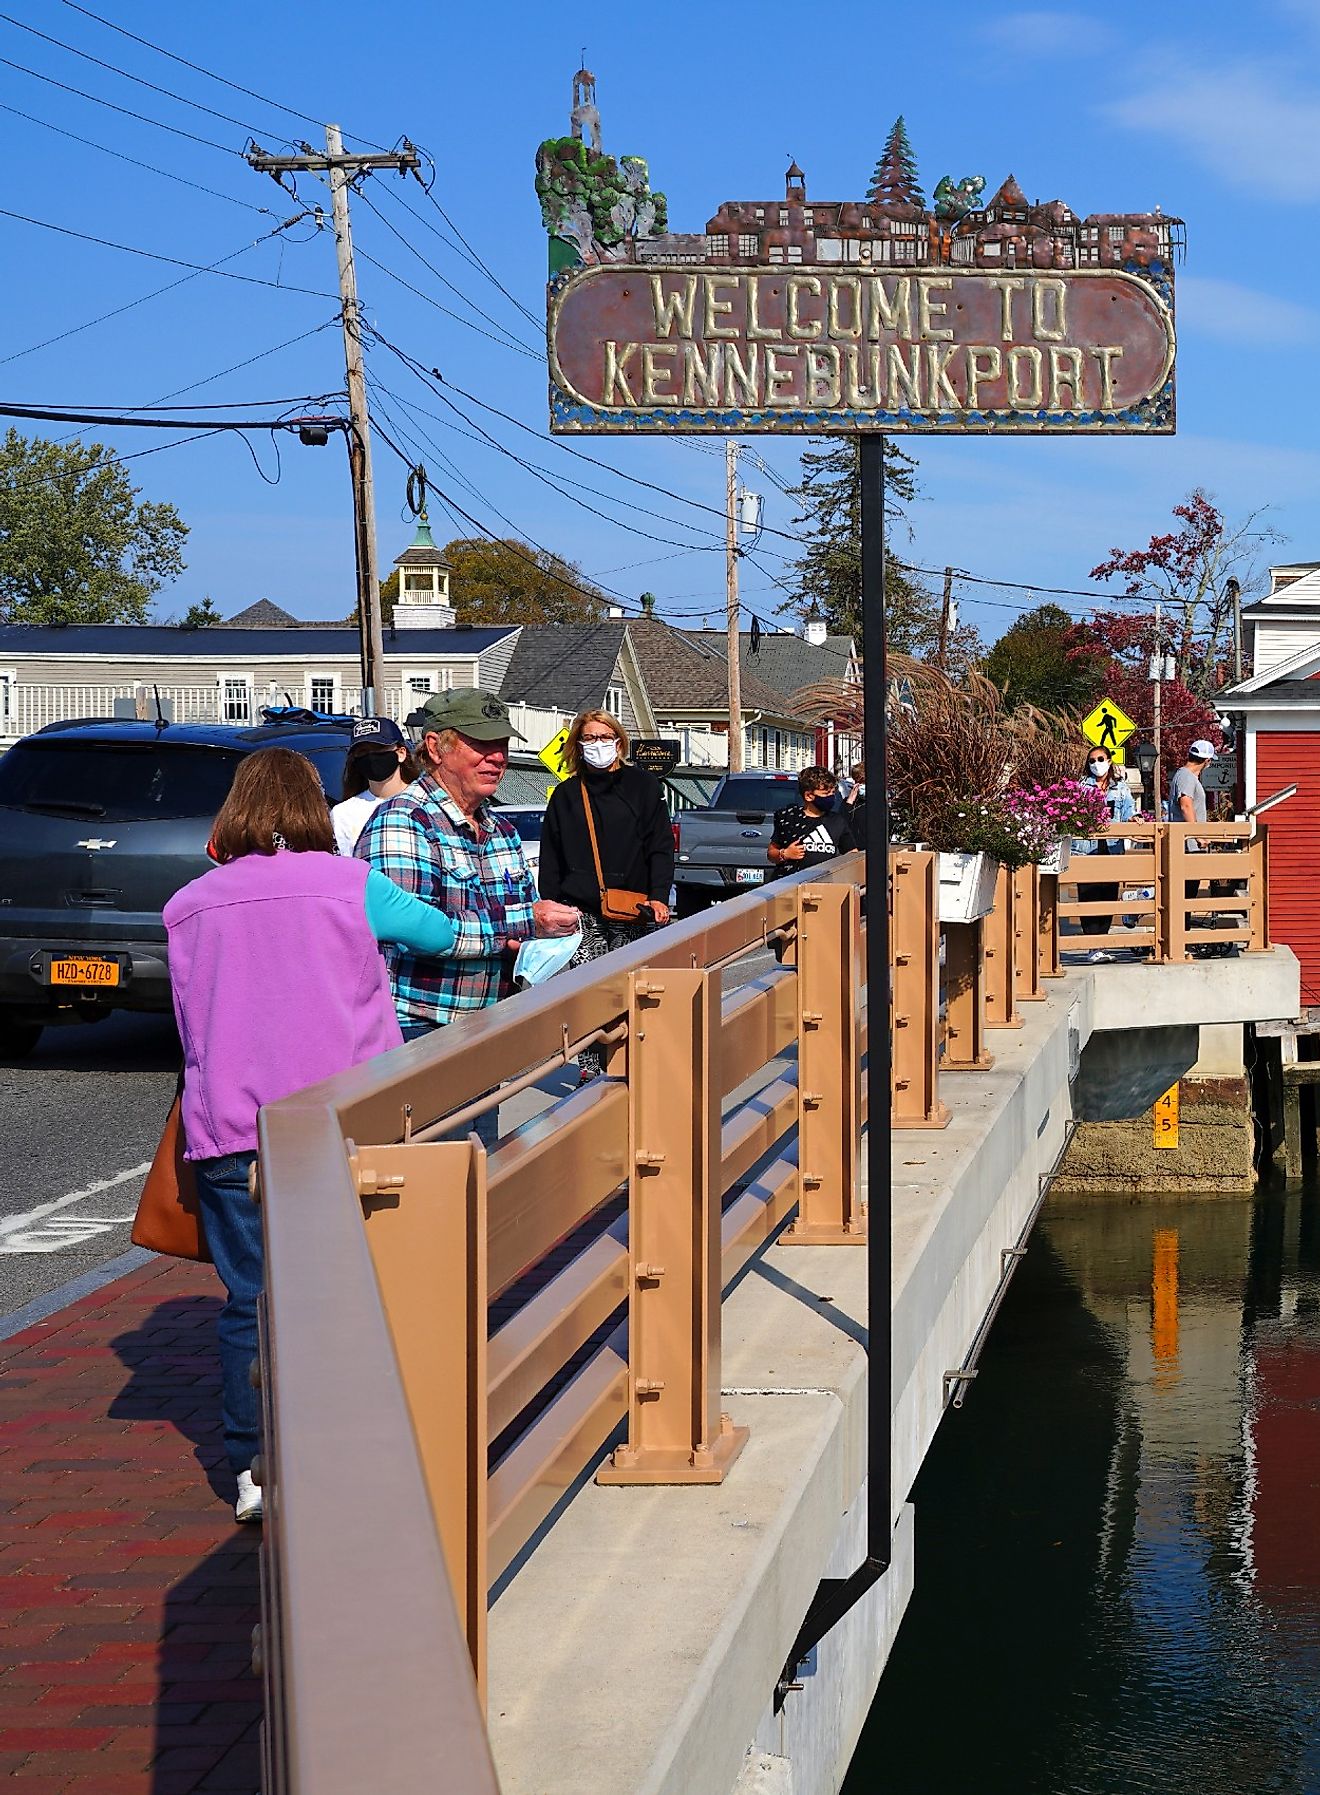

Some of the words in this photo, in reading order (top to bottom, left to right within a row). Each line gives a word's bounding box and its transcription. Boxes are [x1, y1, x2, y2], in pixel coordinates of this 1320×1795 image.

[650, 274, 954, 342] WELCOME
[989, 277, 1067, 342] TO
[602, 340, 1124, 409] KENNEBUNKPORT
[1161, 1095, 1172, 1108] 4
[1161, 1118, 1172, 1131] 5
